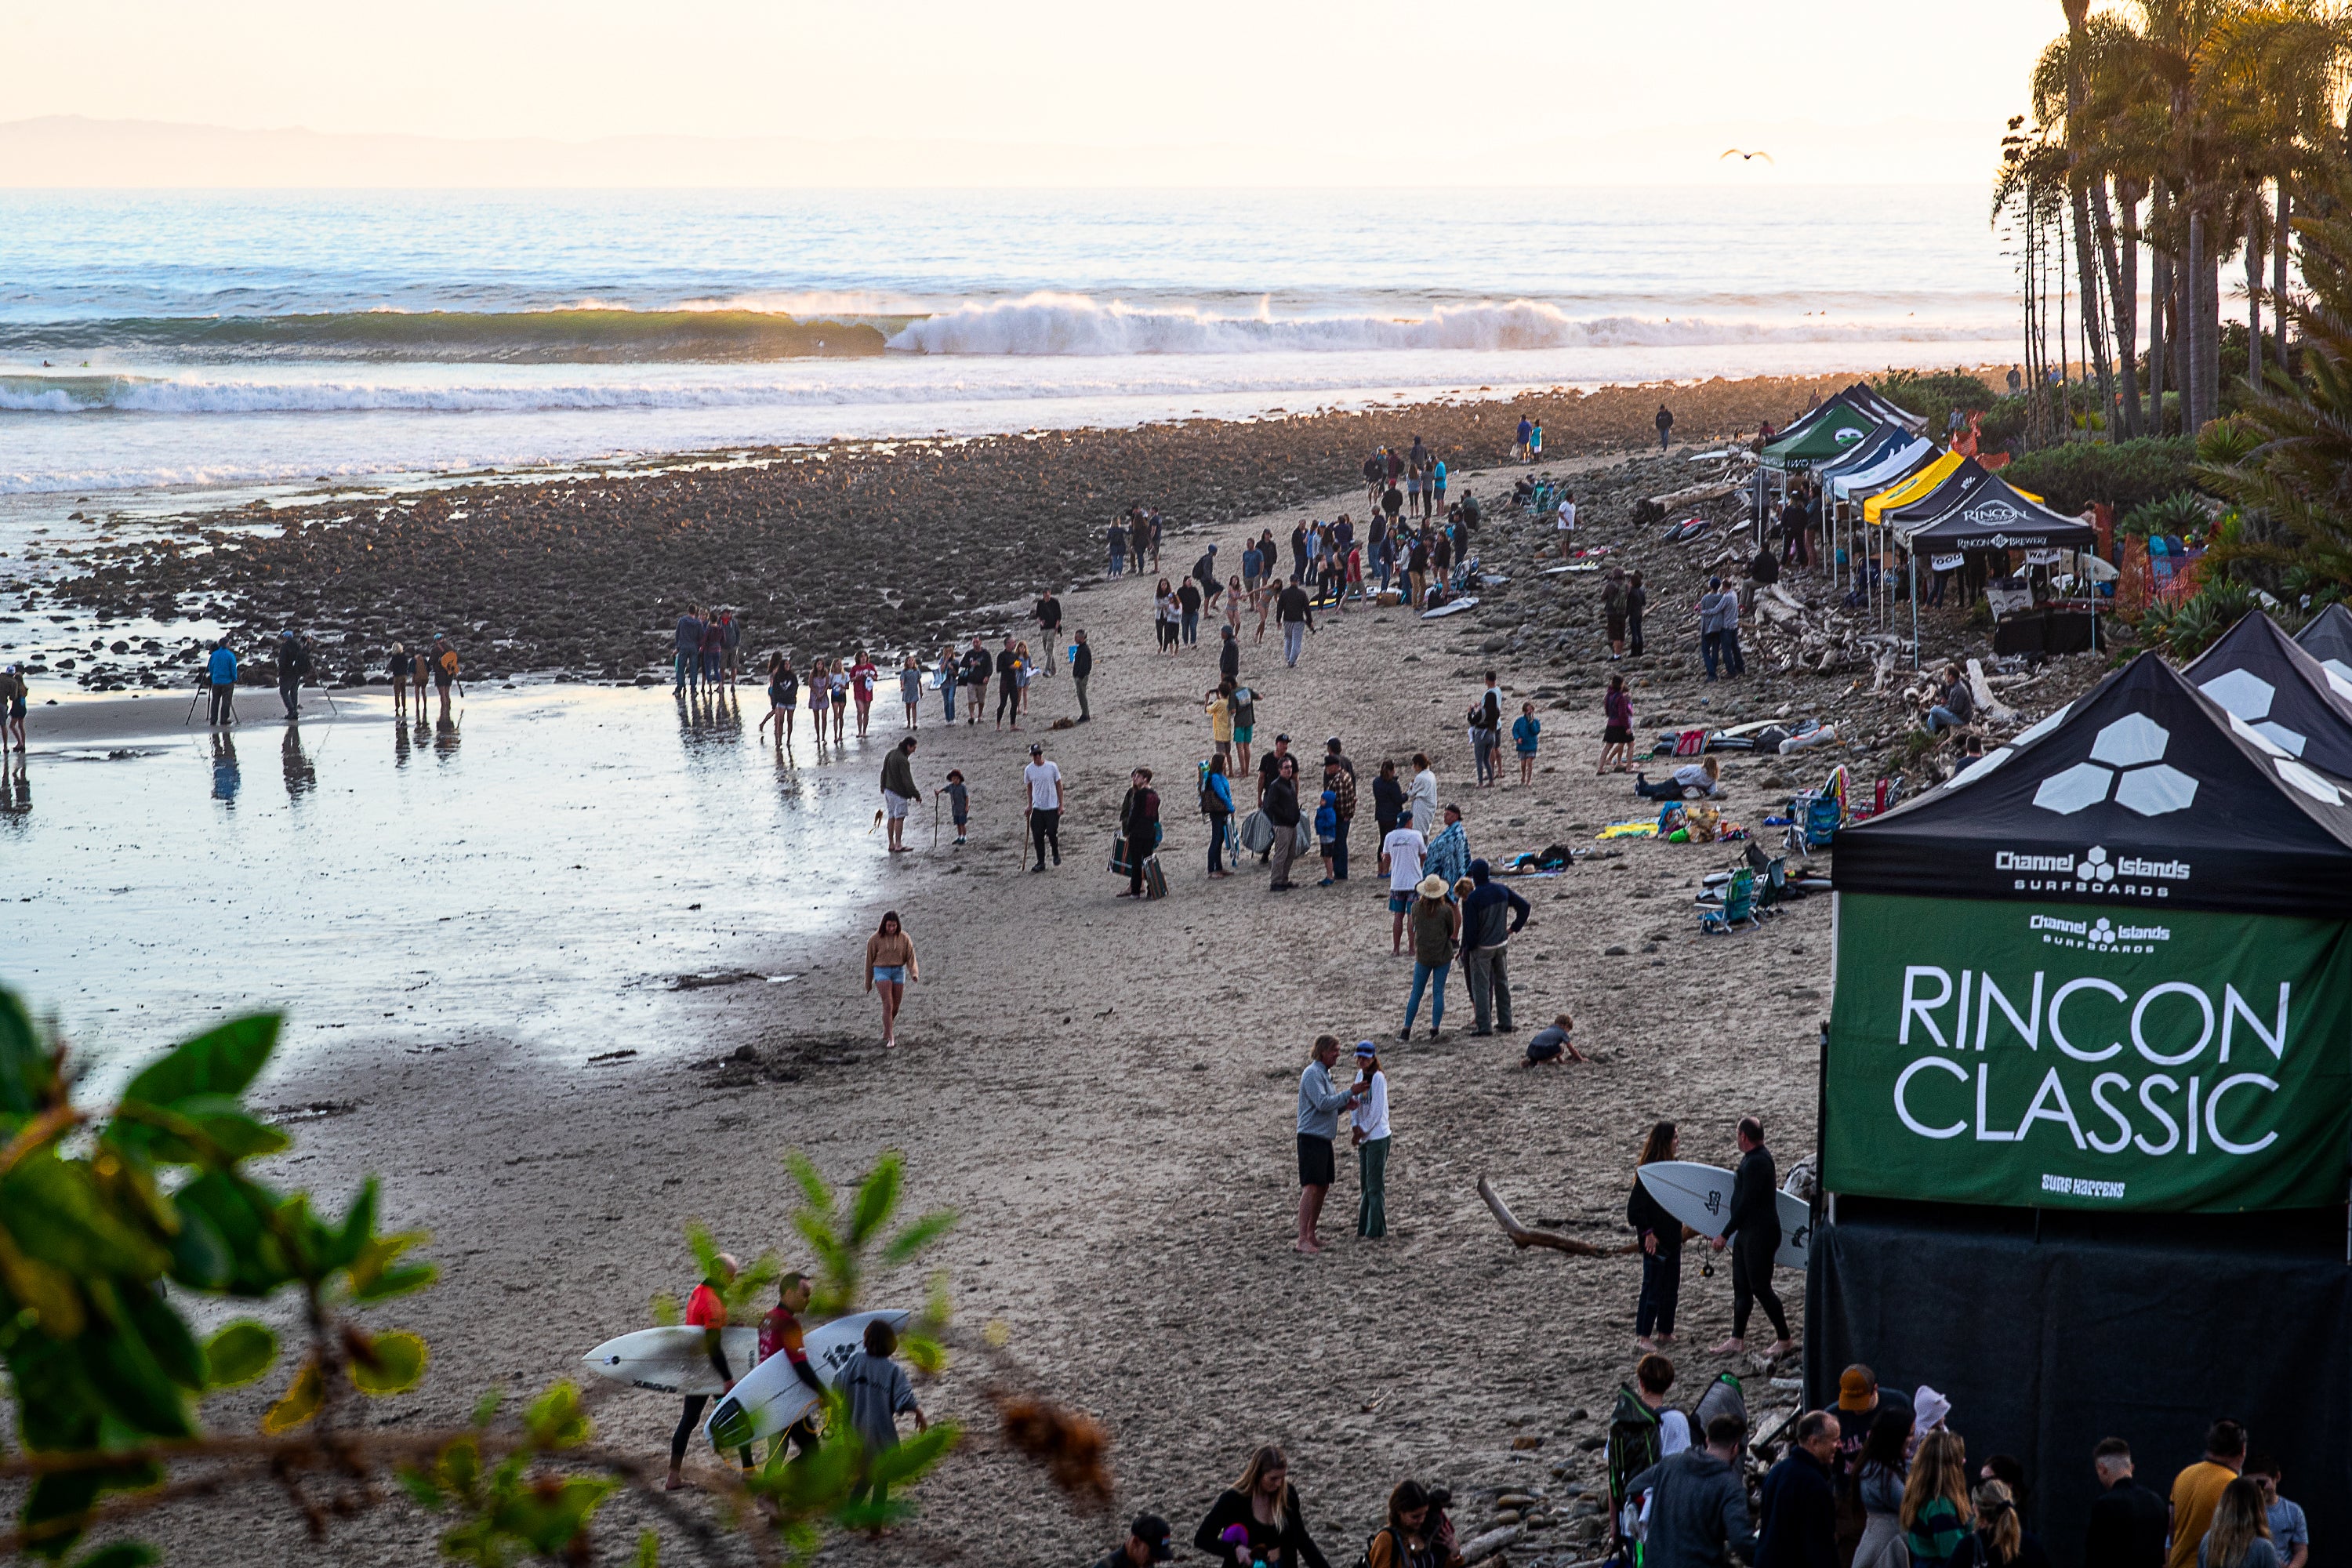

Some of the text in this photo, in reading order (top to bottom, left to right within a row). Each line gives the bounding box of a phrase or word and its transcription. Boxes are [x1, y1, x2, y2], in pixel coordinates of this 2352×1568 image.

[1958, 538, 1990, 549] RINCON
[2009, 536, 2048, 547] BREWERY
[1995, 851, 2190, 880] Channel Islands
[2014, 880, 2169, 897] SURFBOARDS
[2030, 914, 2171, 941] Channel Islands
[2042, 934, 2154, 953] SURFBOARDS
[1898, 965, 2291, 1066] RINCON
[1893, 1055, 2279, 1156] CLASSIC
[2042, 1174, 2072, 1192] SURF
